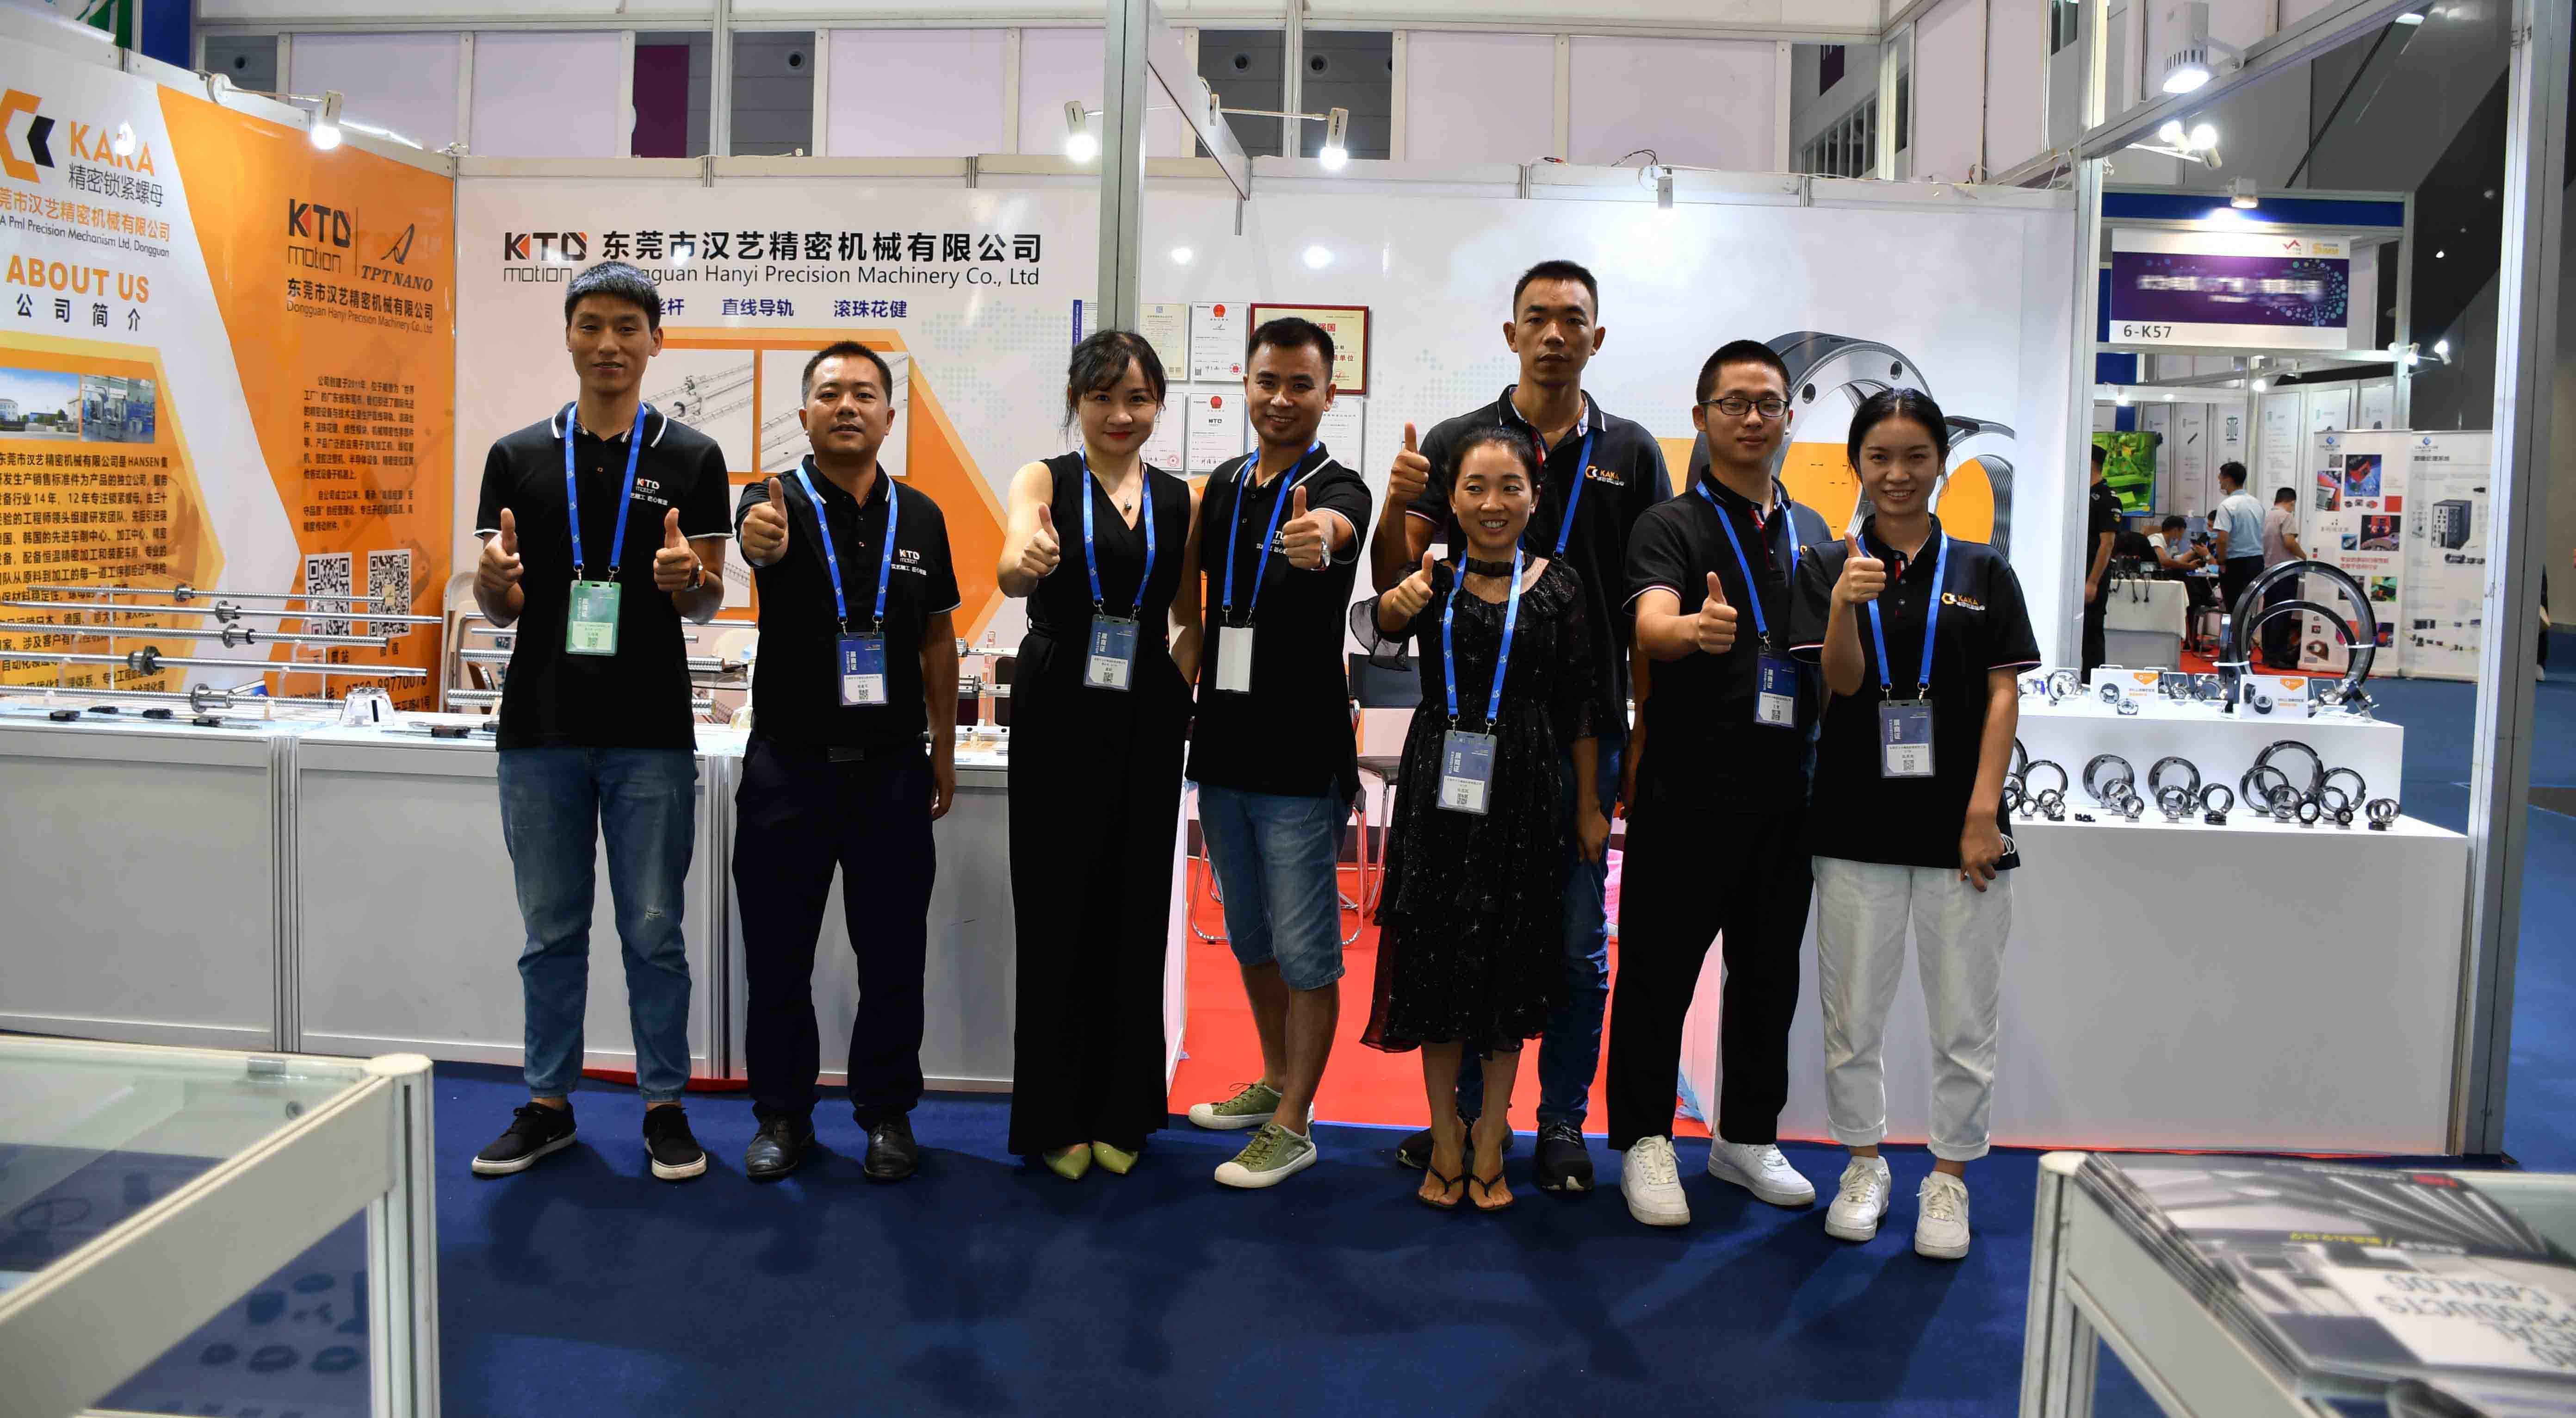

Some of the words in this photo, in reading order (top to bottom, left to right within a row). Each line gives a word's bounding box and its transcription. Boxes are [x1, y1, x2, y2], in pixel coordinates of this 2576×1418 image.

[68, 163, 164, 207] 精密锁紧螺母
[28, 220, 66, 237] Precision
[68, 227, 116, 247] Mechanism
[134, 240, 169, 258] Dongguan
[504, 231, 588, 261] KTD
[602, 230, 1042, 263] 东莞市汉艺精密机械有限公司
[288, 245, 341, 274] motion
[6, 255, 110, 297] ABOUT
[118, 273, 149, 304] US
[503, 266, 573, 283] motion
[643, 268, 697, 286] guan
[706, 265, 758, 287] Hanyi
[766, 265, 850, 283] Precision
[858, 266, 960, 289] Machinery
[966, 267, 1002, 288] Co.,
[1010, 267, 1039, 286] Ltd
[16, 293, 141, 332] 公司简介
[287, 277, 433, 321] 东莞市汉艺精密机械有限公司
[659, 298, 685, 316] 丝杆
[722, 299, 794, 317] 直线导轨
[286, 300, 326, 318] Dongguan
[348, 310, 377, 325] Precision
[378, 315, 410, 334] Machinery
[2123, 324, 2172, 339] 6-K57
[128, 456, 160, 467] HANSEN
[34, 493, 46, 504] 14
[68, 493, 80, 504] 12
[637, 478, 660, 490] KTD
[899, 548, 920, 560] KTD
